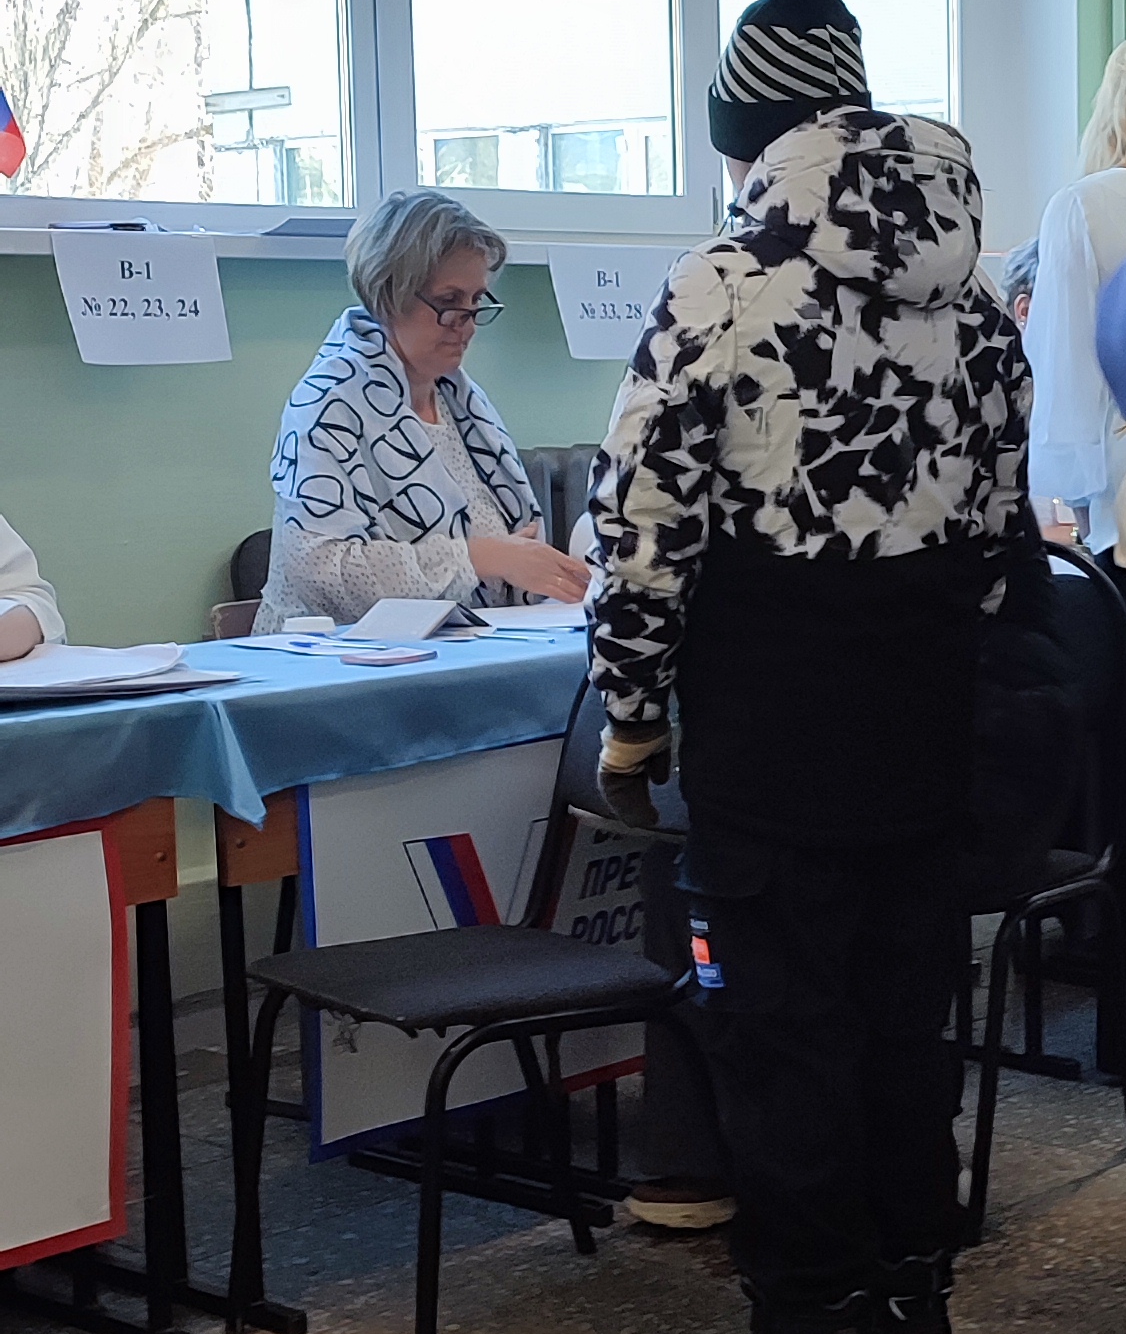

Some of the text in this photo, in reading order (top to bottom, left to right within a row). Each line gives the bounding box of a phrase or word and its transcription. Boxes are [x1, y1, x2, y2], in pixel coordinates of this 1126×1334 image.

[81, 296, 200, 321] № 22, 23, 24
[600, 302, 621, 321] 33,
[625, 303, 643, 319] 28
[579, 851, 647, 900] ПРЕ
